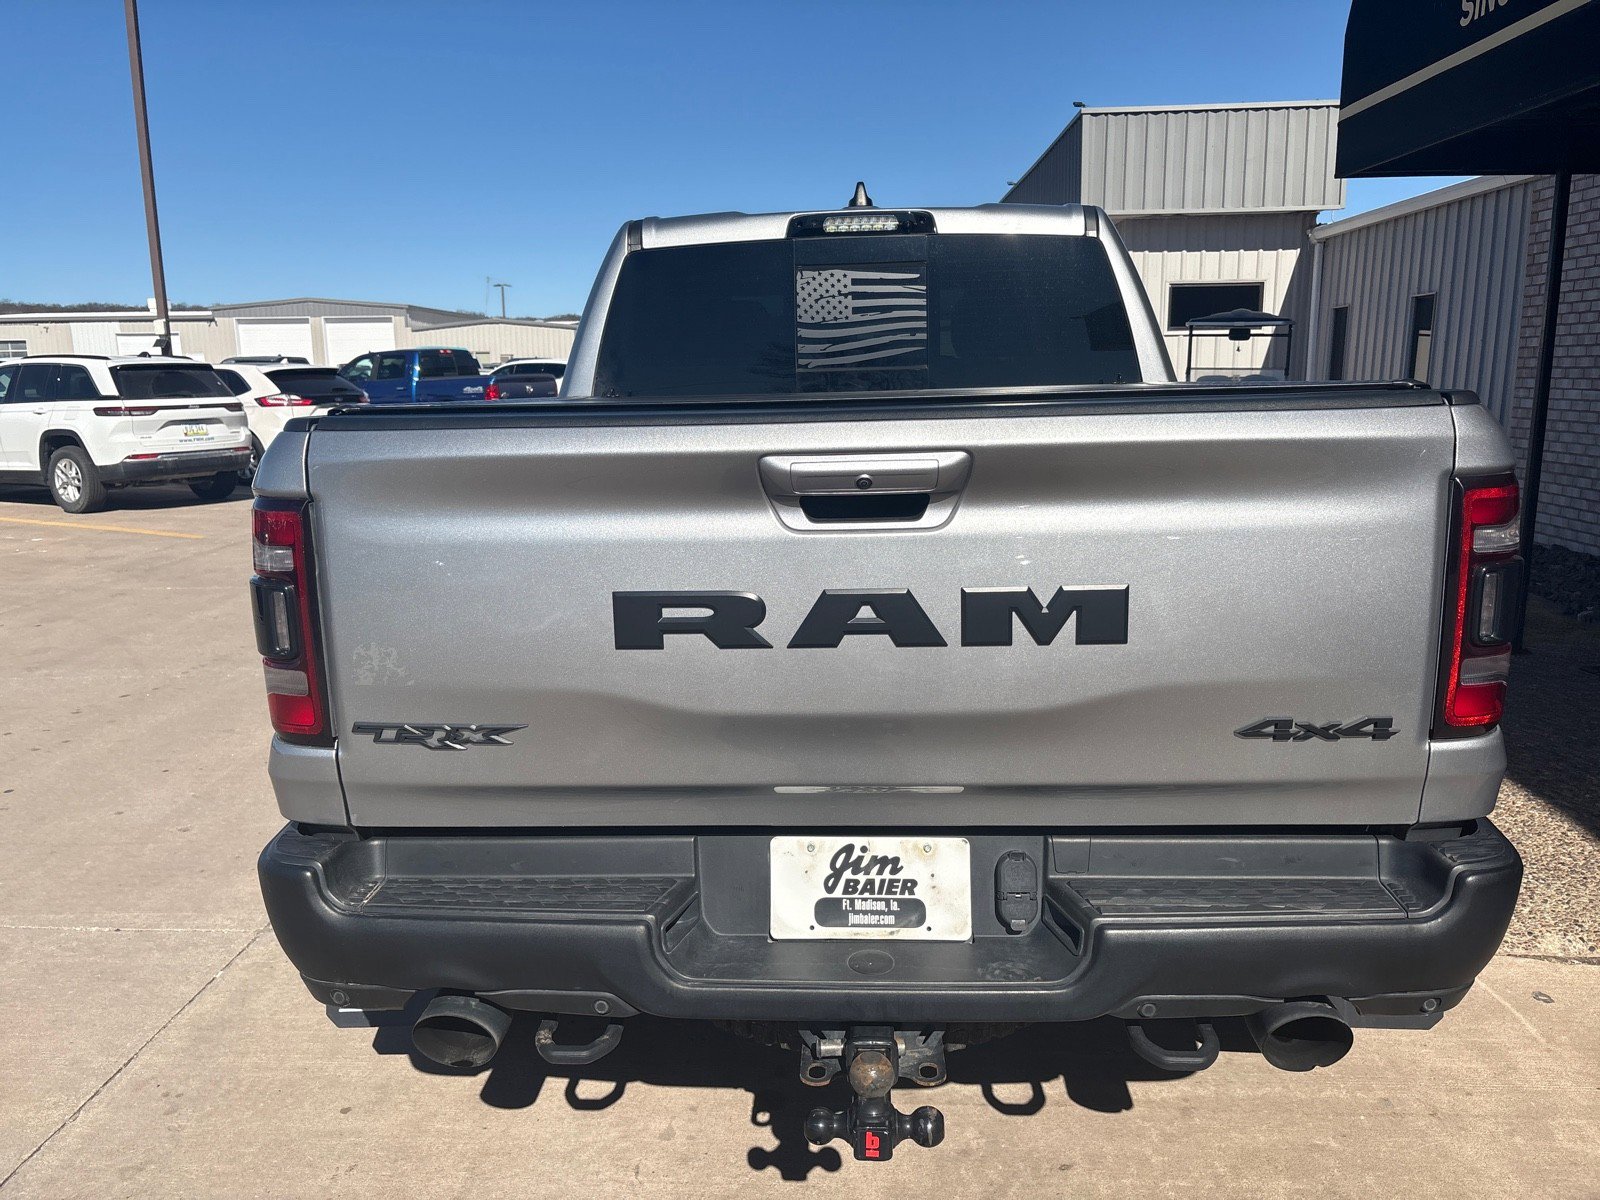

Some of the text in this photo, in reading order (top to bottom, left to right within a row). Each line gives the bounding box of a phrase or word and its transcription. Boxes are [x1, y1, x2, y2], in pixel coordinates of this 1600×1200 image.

[612, 584, 1130, 650] RAM
[352, 722, 529, 750] TRX
[1233, 715, 1401, 742] 4x4
[823, 843, 904, 894] Jim
[842, 878, 919, 896] BAIER
[842, 899, 852, 911] Ft.
[854, 898, 888, 912] Madison,
[848, 912, 895, 926] jimbaier.com
